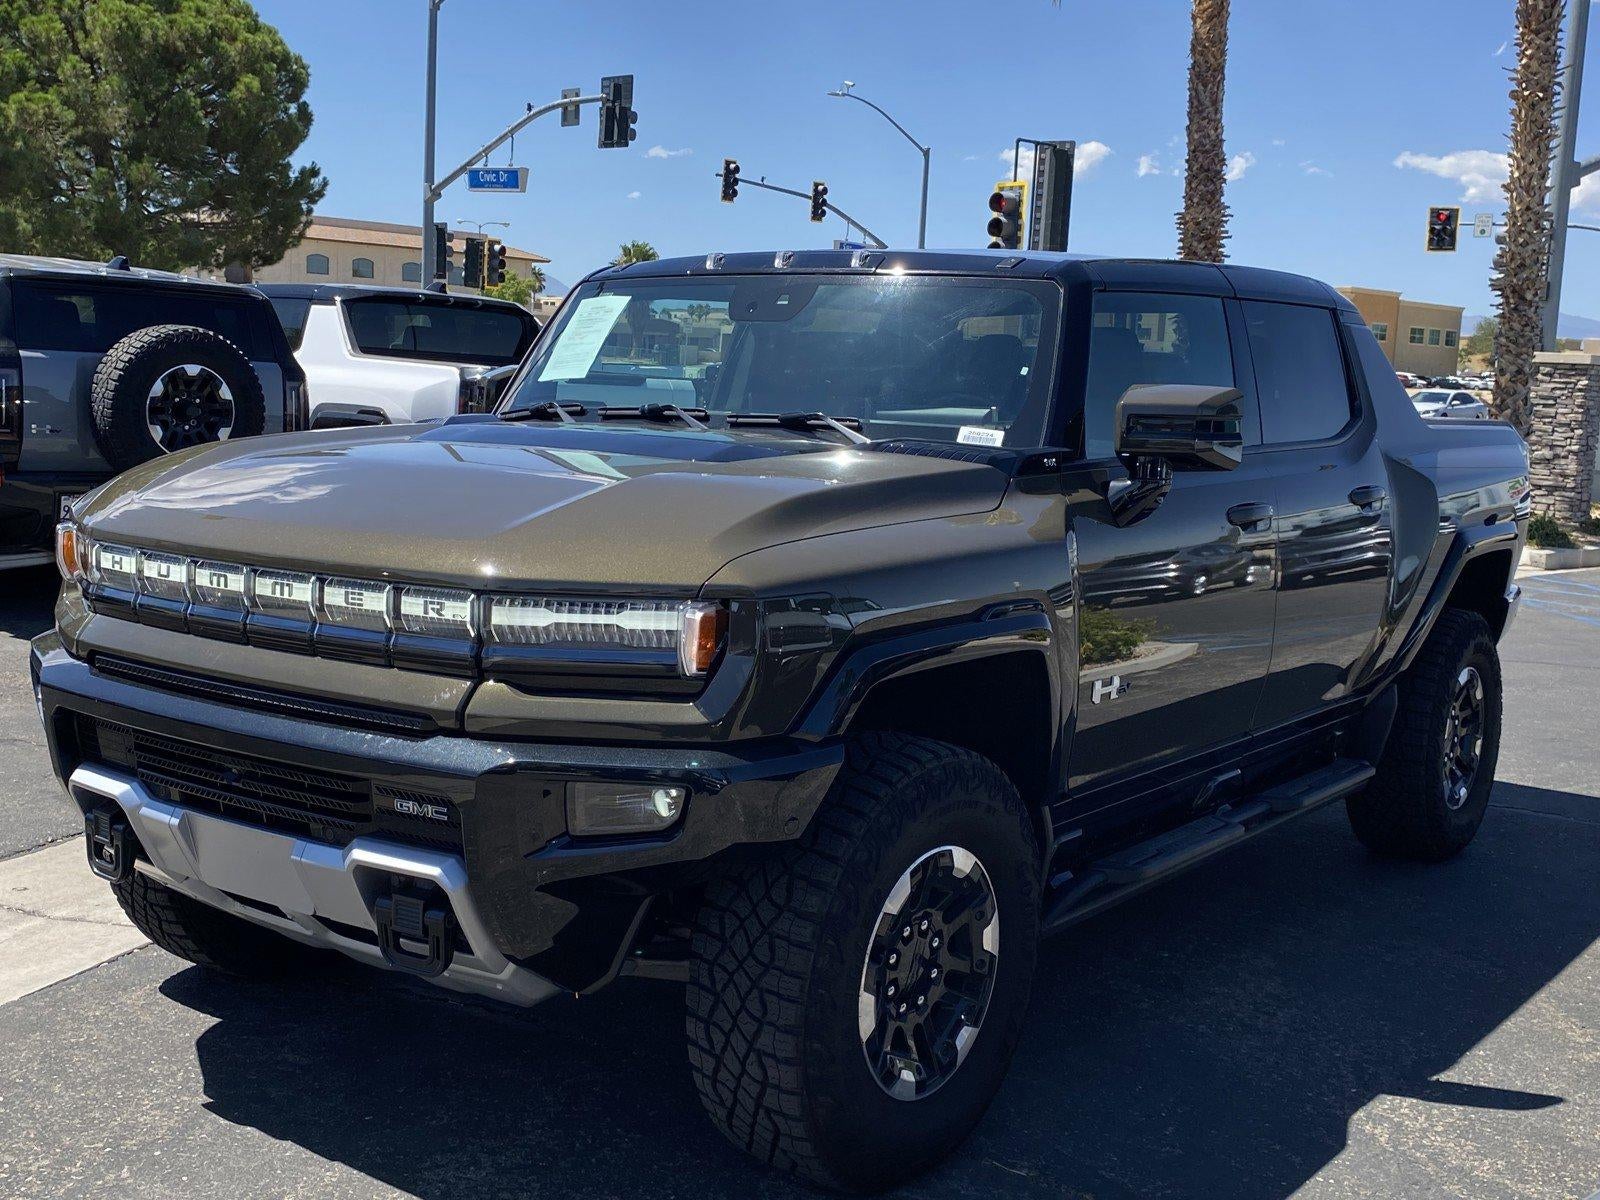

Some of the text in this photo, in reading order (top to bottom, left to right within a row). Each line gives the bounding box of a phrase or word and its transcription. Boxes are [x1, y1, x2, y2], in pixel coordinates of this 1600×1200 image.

[479, 171, 508, 182] Civic Dr
[111, 555, 445, 618] HUMMER
[394, 798, 448, 820] GMC
